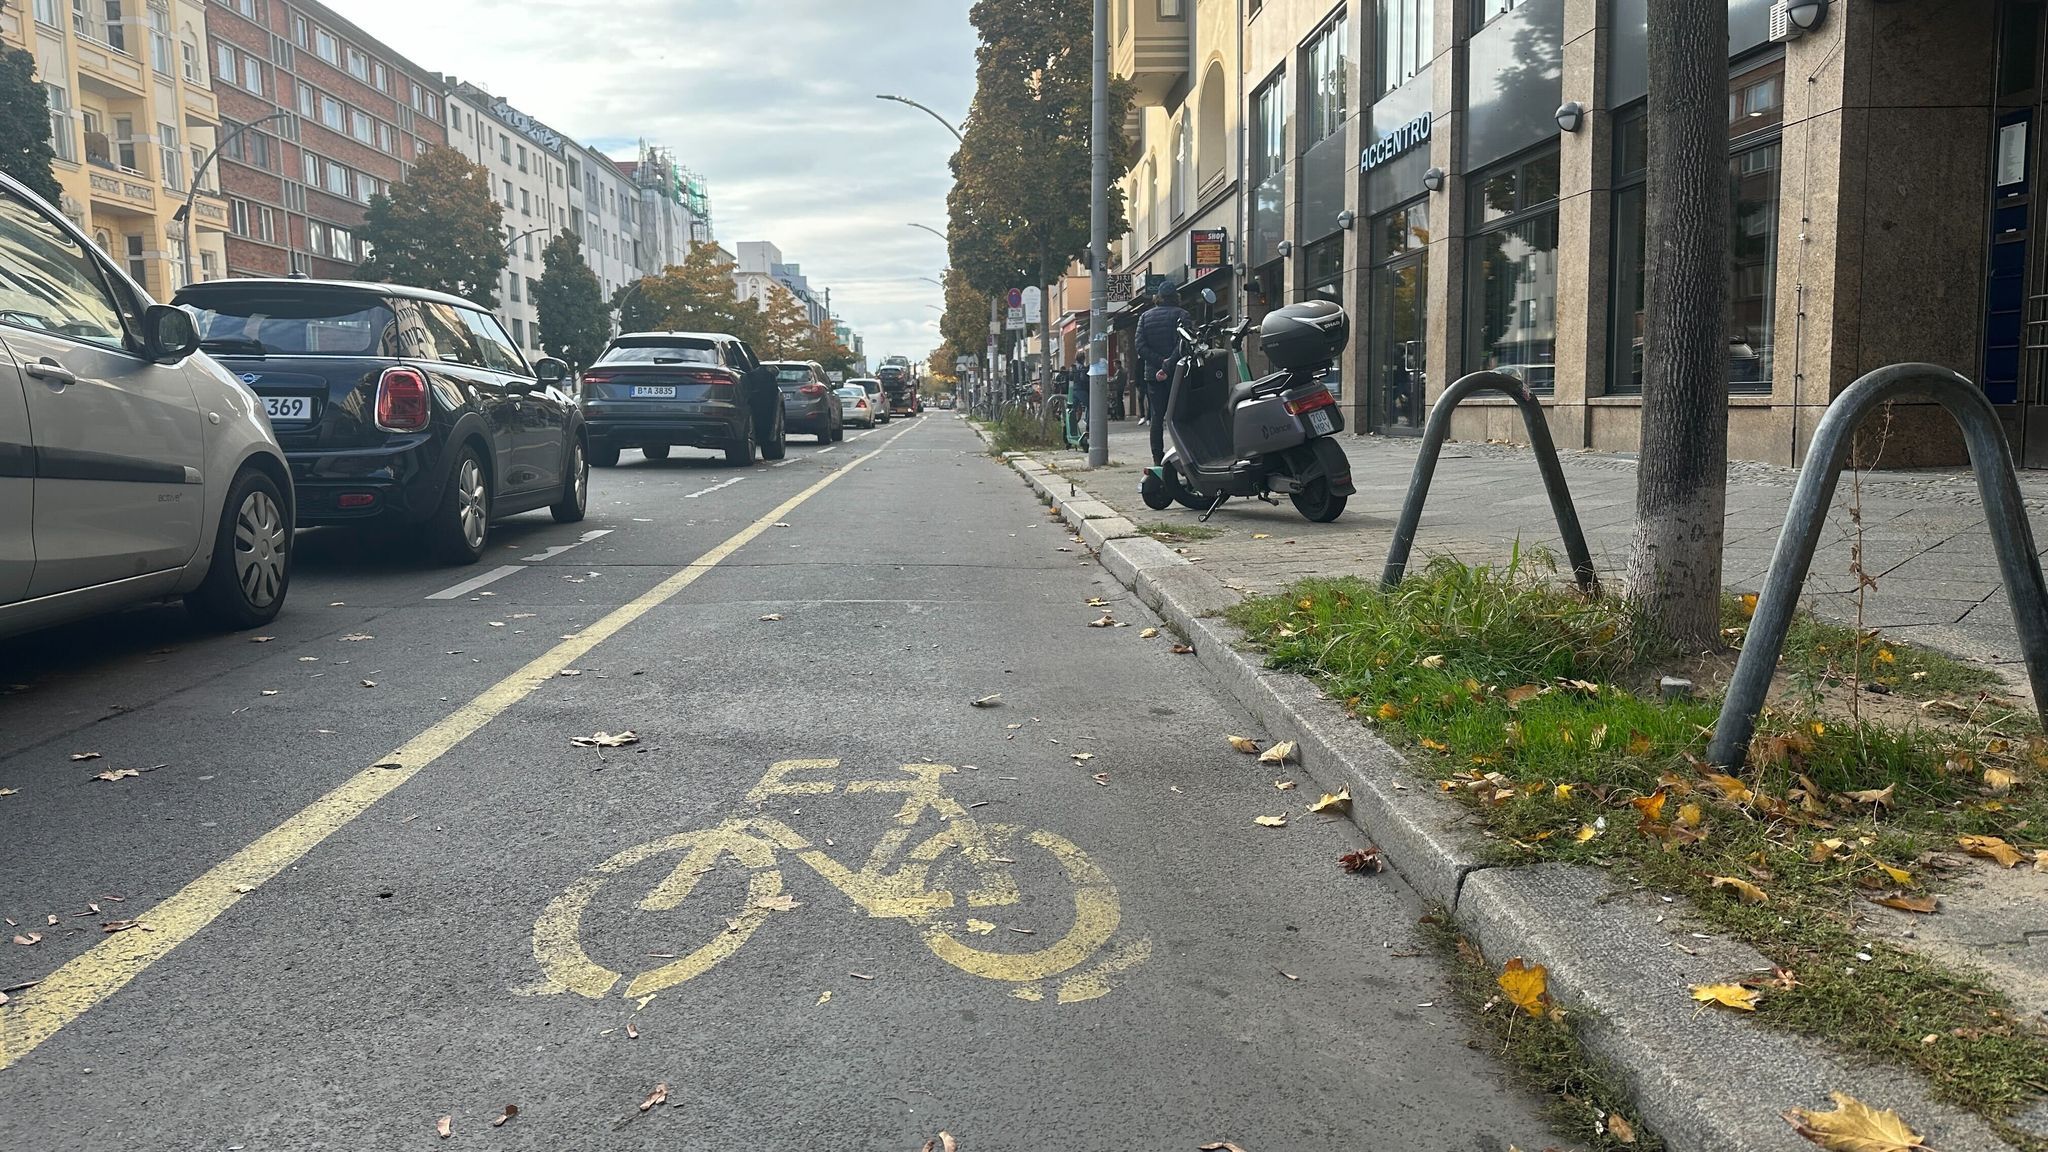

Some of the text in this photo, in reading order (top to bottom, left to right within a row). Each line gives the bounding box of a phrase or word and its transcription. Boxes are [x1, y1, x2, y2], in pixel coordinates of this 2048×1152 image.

[1360, 112, 1431, 174] ACCENTRO
[1208, 233, 1225, 243] SHOP
[637, 387, 673, 395] B A 3835
[267, 398, 304, 417] 369
[1310, 411, 1327, 424] 700
[1314, 421, 1332, 434] MRY
